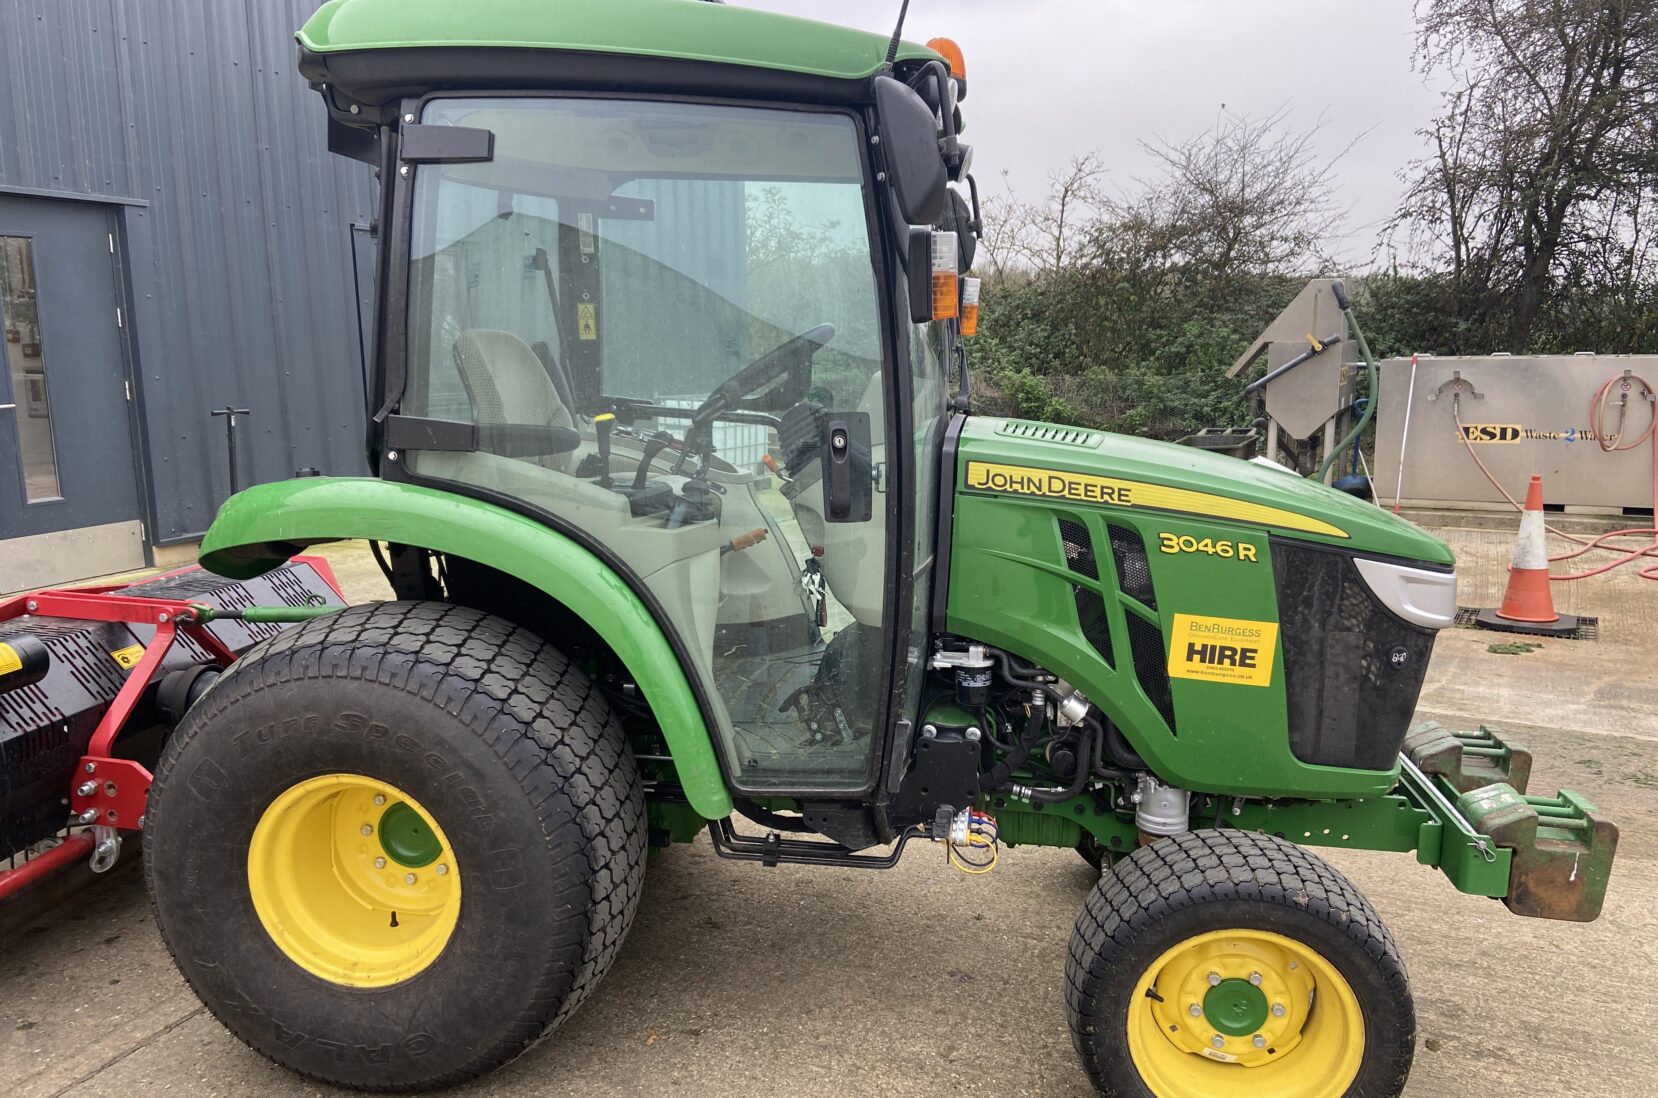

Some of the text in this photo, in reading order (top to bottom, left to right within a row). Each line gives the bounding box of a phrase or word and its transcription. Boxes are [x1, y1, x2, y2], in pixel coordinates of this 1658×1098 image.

[1461, 426, 1616, 442] ESD Waste 2 Waer
[977, 469, 1132, 503] JOHN DEERE
[1186, 642, 1258, 669] HIRE
